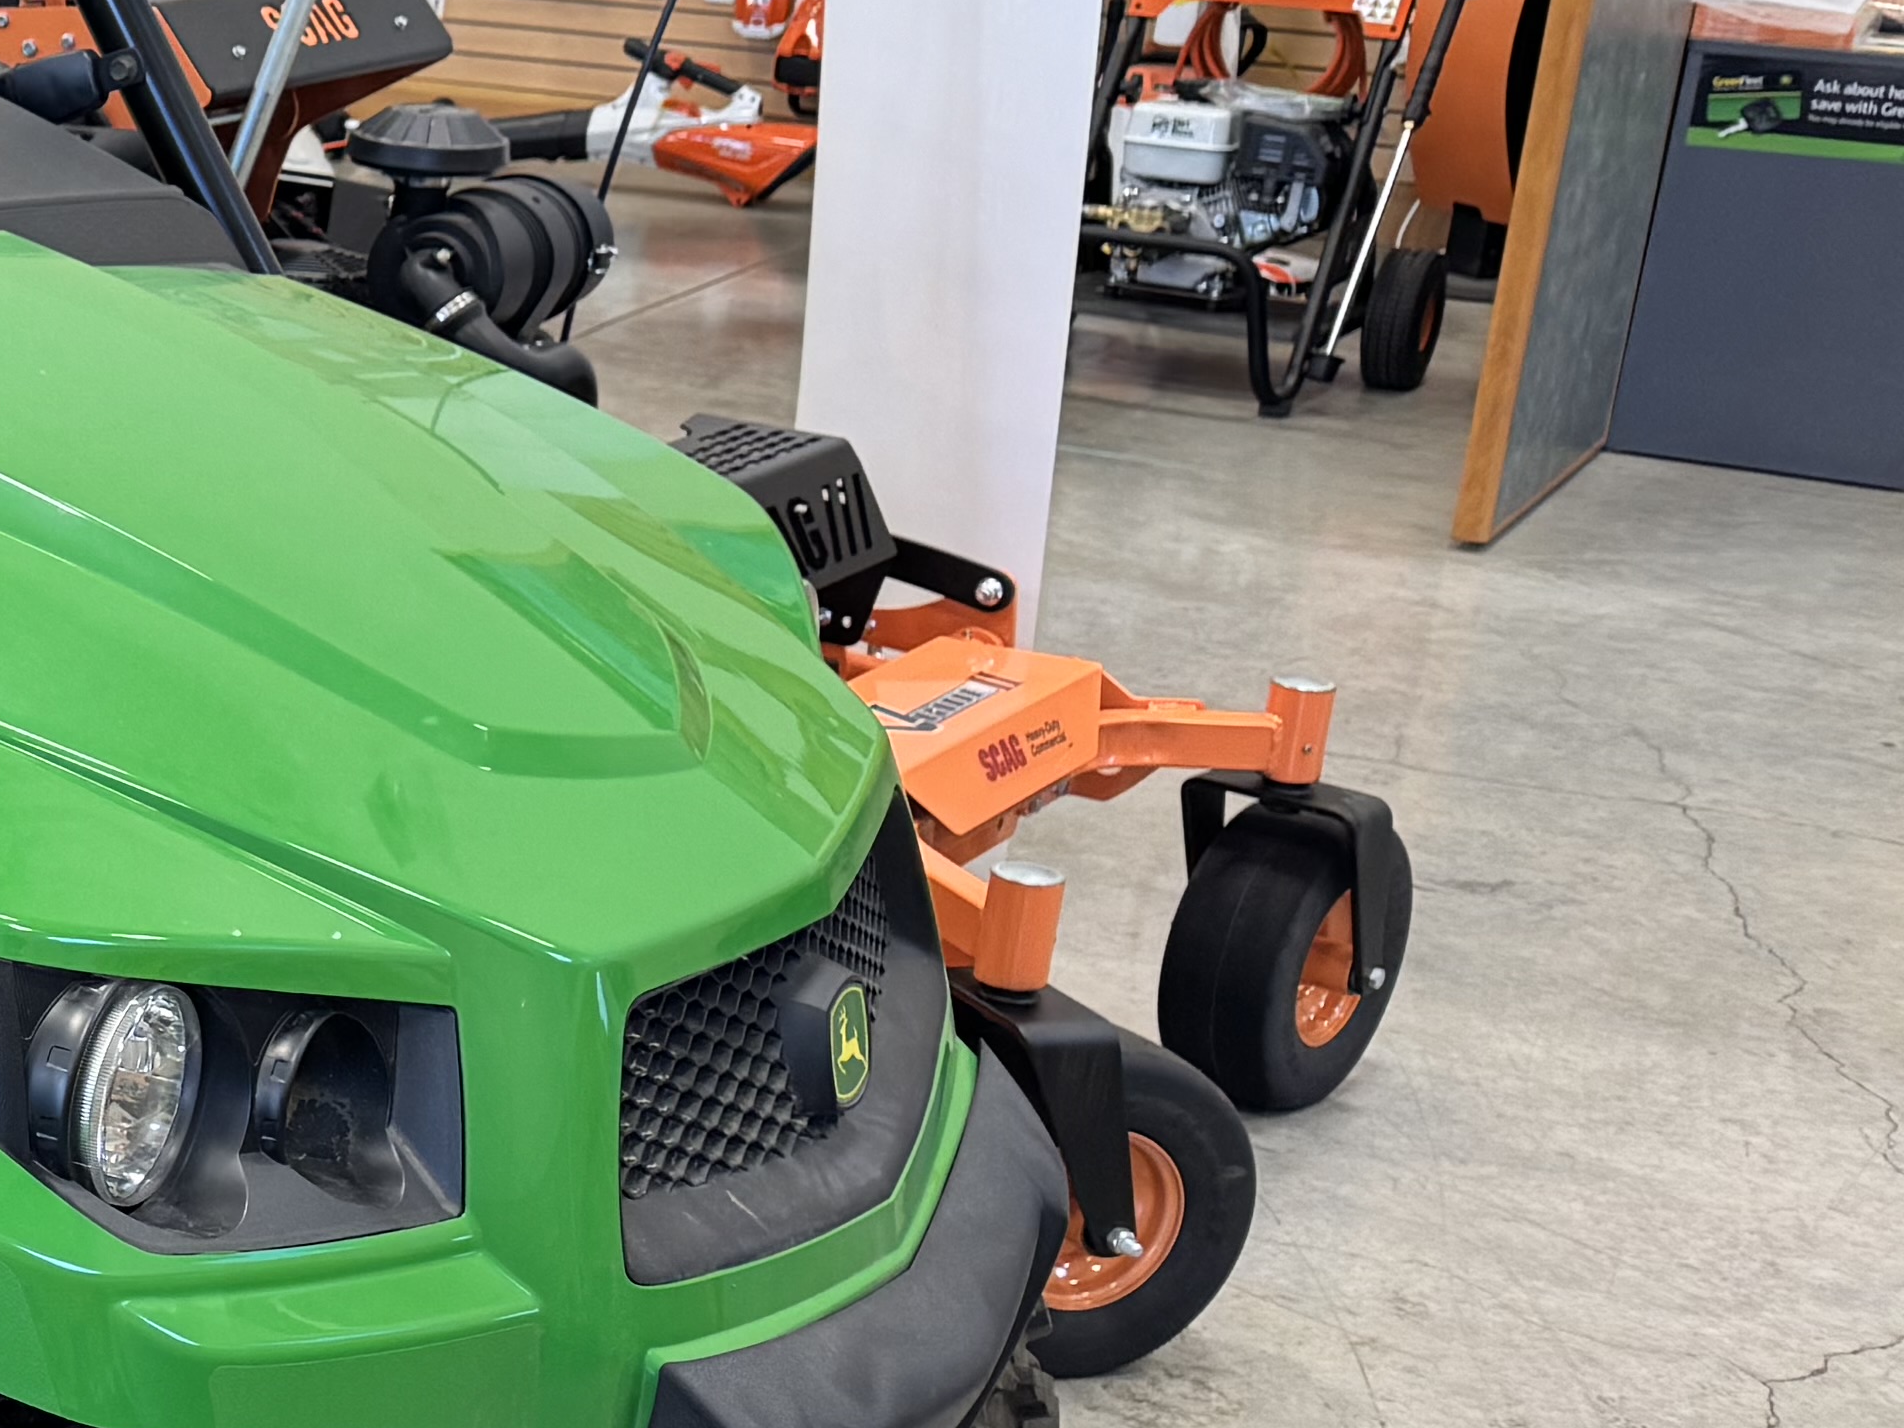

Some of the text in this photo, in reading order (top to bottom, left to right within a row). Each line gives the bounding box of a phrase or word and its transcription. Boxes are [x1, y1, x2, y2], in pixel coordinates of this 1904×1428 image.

[1814, 79, 1841, 94] Ask
[1844, 81, 1886, 99] about
[1810, 99, 1842, 113] save
[1845, 100, 1877, 116] with
[978, 733, 1028, 782] SCAG
